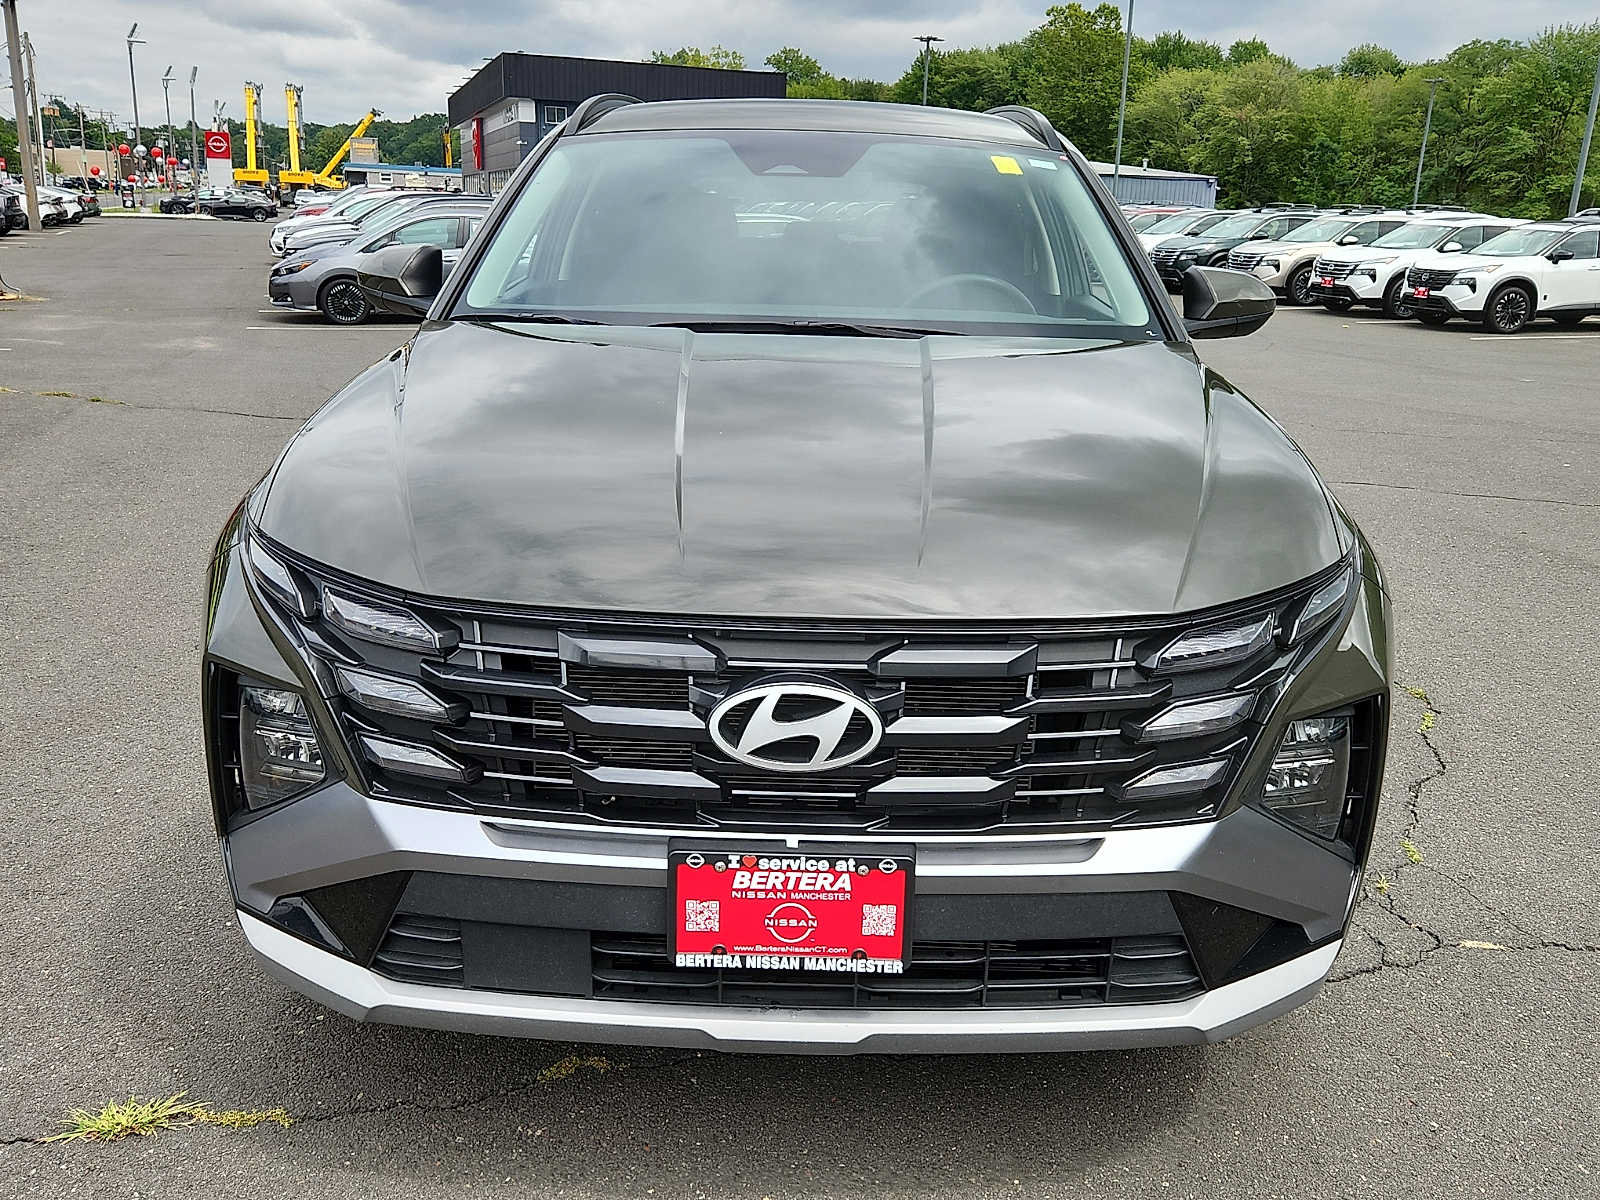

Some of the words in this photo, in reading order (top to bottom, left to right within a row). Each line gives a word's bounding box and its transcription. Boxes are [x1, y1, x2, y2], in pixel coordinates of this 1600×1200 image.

[728, 855, 740, 868] I
[758, 856, 830, 871] service
[835, 858, 856, 872] at
[732, 871, 852, 891] BERTERA
[731, 890, 787, 899] NISSAN
[791, 892, 851, 900] MANCHESTER
[764, 918, 818, 927] NISSAN
[733, 944, 848, 953] www.BerteraNissanCT.com
[675, 954, 742, 968] BERTERA
[745, 955, 800, 970] NISSAN
[803, 957, 904, 974] MANCHESTER
